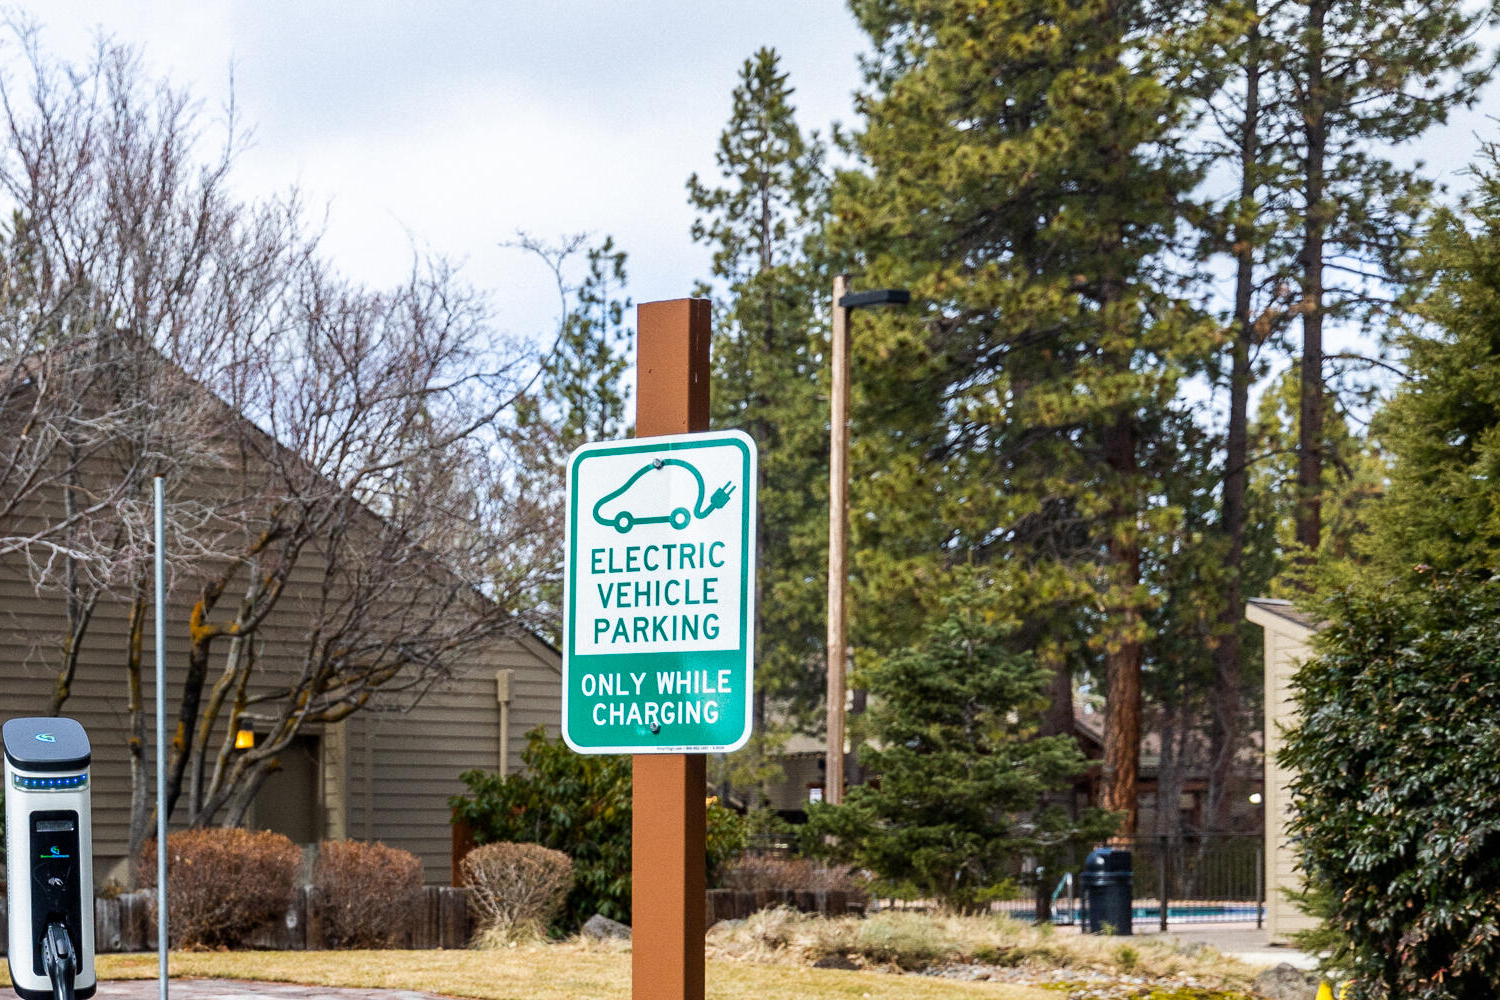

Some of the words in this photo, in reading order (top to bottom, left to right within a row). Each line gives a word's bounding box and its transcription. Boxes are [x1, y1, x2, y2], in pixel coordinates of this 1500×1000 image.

[591, 541, 725, 575] ELECTRIC
[597, 577, 719, 609] VEHICLE
[594, 613, 720, 644] PARKING
[581, 672, 647, 697] ONLY
[656, 669, 732, 695] WHILE
[592, 701, 719, 726] CHARGING
